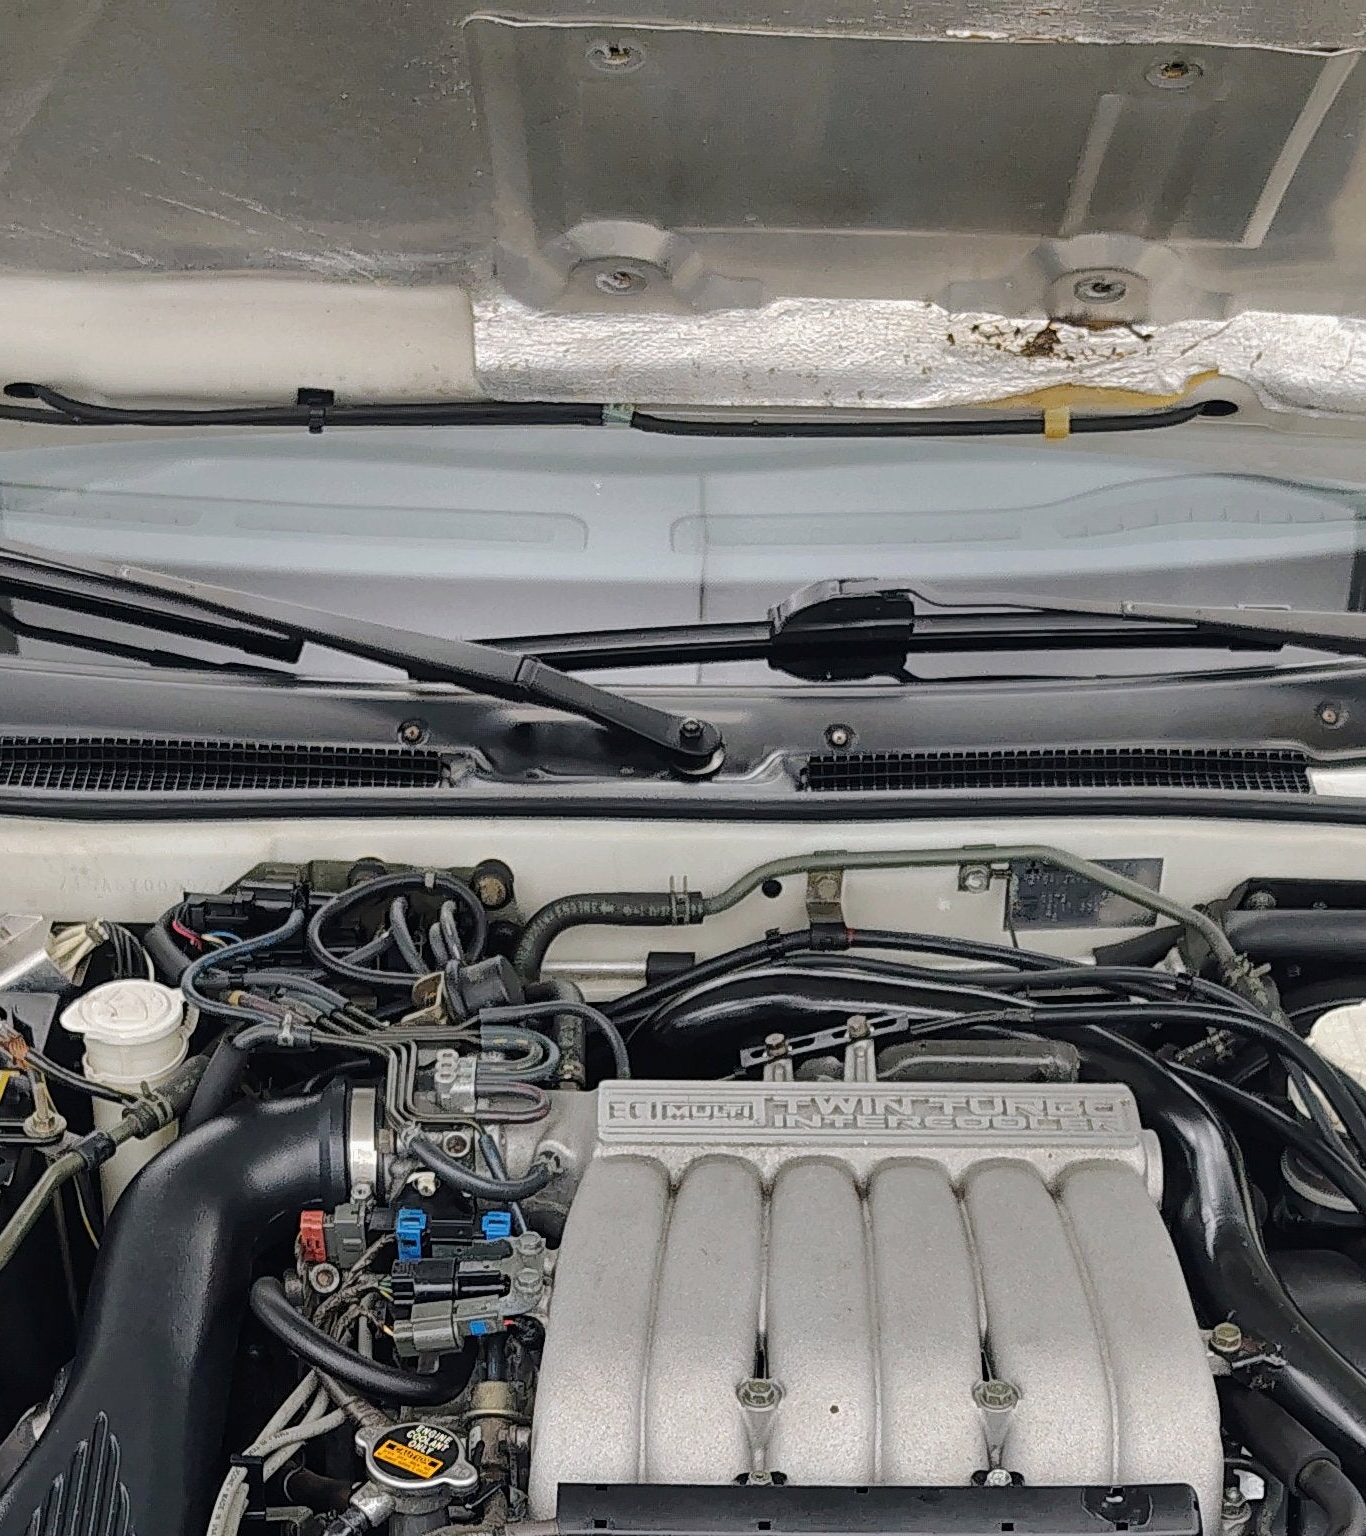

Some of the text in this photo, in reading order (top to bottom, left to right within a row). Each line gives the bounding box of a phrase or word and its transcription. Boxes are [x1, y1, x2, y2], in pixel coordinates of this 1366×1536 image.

[668, 1104, 754, 1121] MULTI
[770, 1096, 1117, 1116] TWIN TURBO
[772, 1115, 1123, 1131] INTERCOOLER
[406, 1430, 450, 1453] COOLANT
[415, 1424, 454, 1445] ENGINE
[407, 1440, 435, 1455] ONLY
